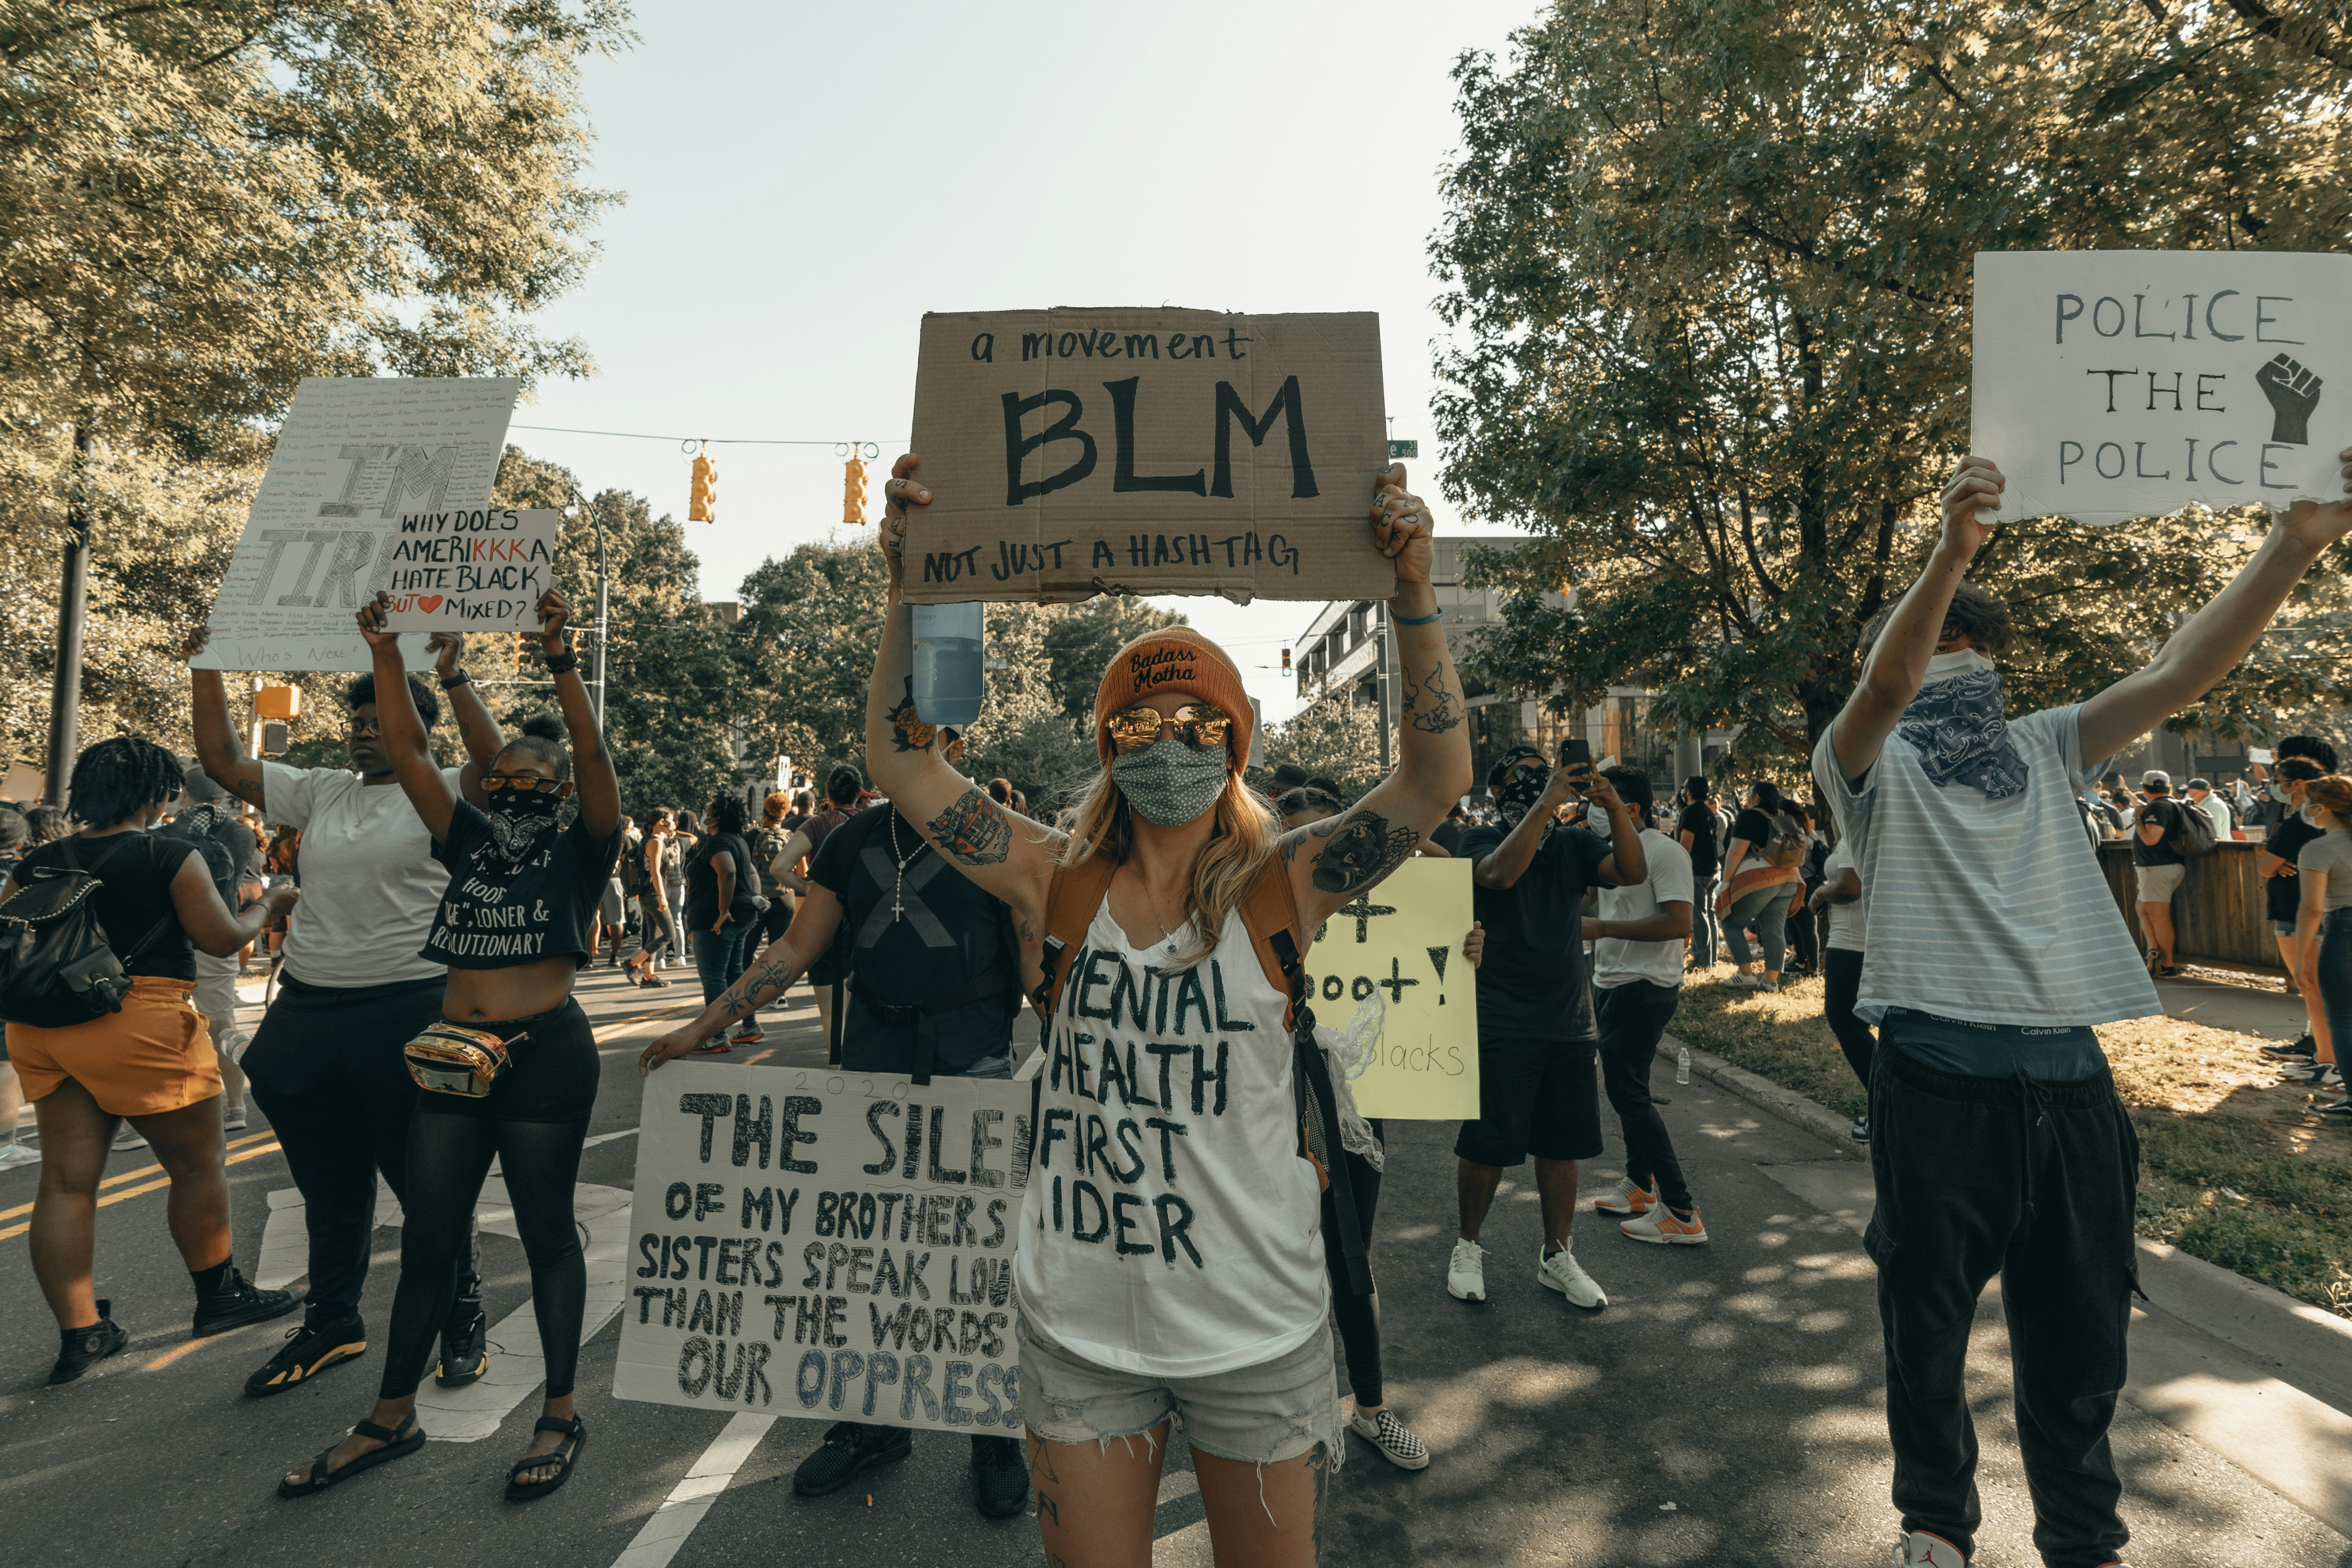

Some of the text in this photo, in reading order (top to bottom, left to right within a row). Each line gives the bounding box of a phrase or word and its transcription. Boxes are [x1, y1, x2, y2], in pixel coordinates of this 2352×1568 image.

[2056, 289, 2305, 345] POLICE
[971, 328, 1254, 363] a movement
[2087, 367, 2225, 413] THE
[1001, 375, 1320, 506] BLM
[1402, 449, 1416, 457] 500
[2060, 438, 2299, 489] POLICE
[284, 520, 315, 530] George
[401, 510, 518, 533] WHY DOES
[393, 538, 550, 565] AMERIKKKA
[924, 545, 982, 583] NOT
[991, 539, 1073, 581] JUST
[1092, 540, 1114, 570] A
[391, 566, 540, 600] HATE BLACK
[238, 646, 291, 666] Who's
[307, 645, 346, 662] Next
[1130, 648, 1197, 673] Badass
[1134, 664, 1196, 693] Motha
[476, 905, 526, 928] LONER
[534, 899, 550, 921] &
[1970, 1022, 1997, 1031] Klein
[2021, 1027, 2051, 1035] Calvin
[795, 1073, 908, 1100] 2020
[1050, 1026, 1229, 1116] HEALTH
[680, 1092, 823, 1174] THE
[1040, 1108, 1188, 1187] FIRST
[665, 1181, 1007, 1248] OF MY BROTHERS
[1039, 1175, 1204, 1270] IDER
[637, 1233, 1019, 1308] SISTERS SPEAK LOU
[634, 1286, 1008, 1358] THAN THE WORDS
[678, 1335, 772, 1407] OUR
